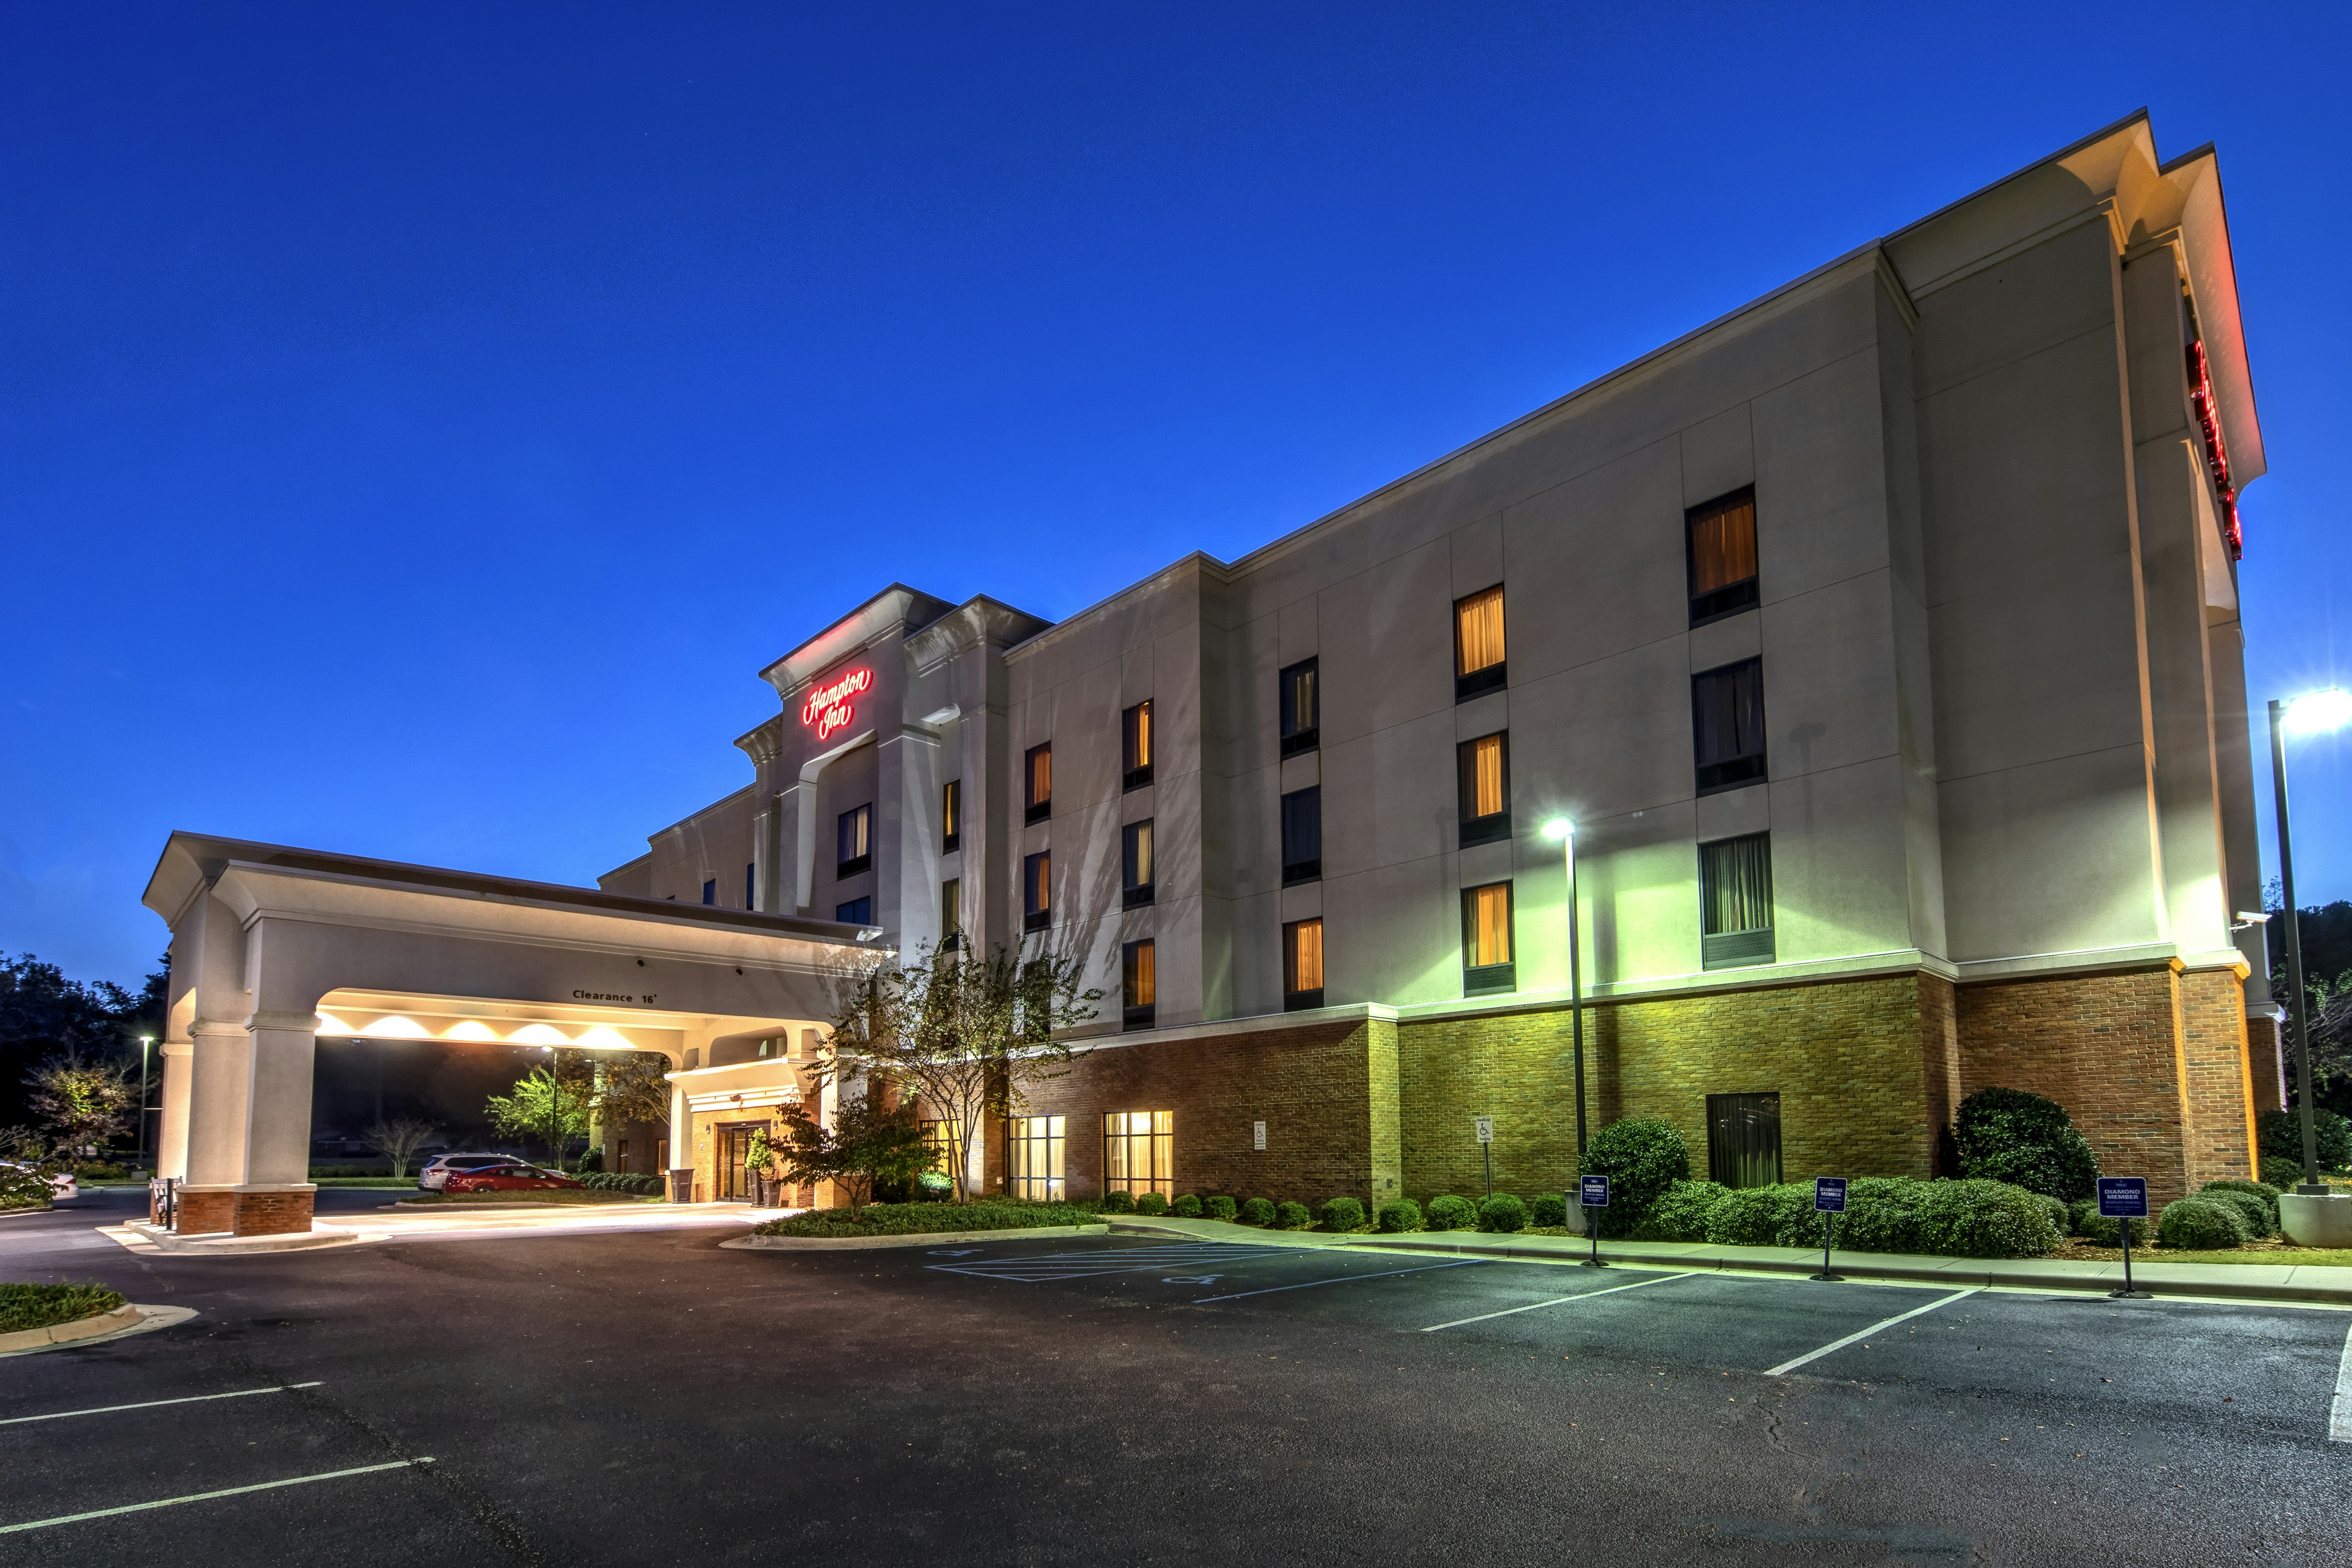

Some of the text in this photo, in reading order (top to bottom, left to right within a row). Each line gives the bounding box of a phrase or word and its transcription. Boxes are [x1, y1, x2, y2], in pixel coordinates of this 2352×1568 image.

[803, 670, 873, 725] Hampton
[818, 705, 855, 740] Inn
[573, 990, 633, 1002] Clearance
